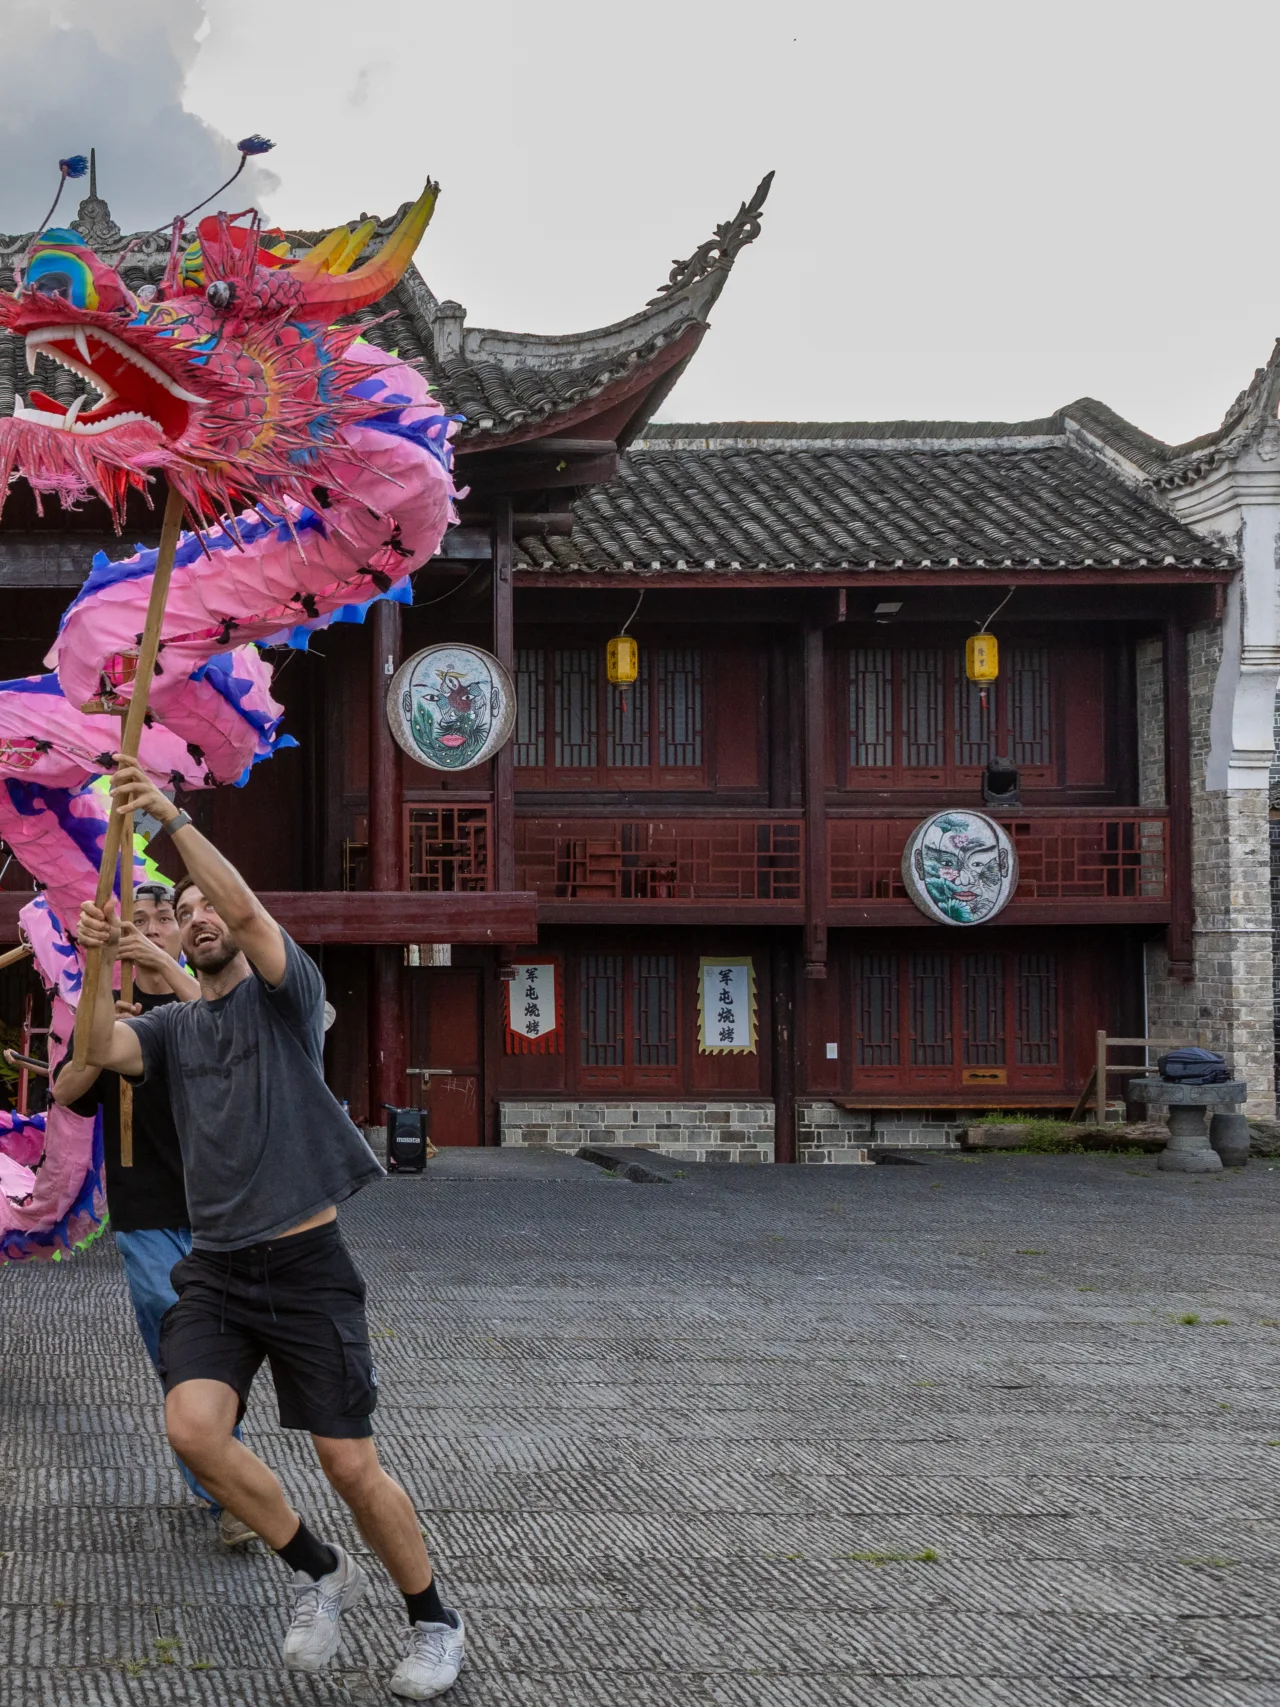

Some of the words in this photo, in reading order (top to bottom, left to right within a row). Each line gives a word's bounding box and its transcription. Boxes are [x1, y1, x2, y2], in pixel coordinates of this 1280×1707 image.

[524, 967, 541, 1035] 军屯烧烤
[717, 968, 736, 1043] 军屯烧烤
